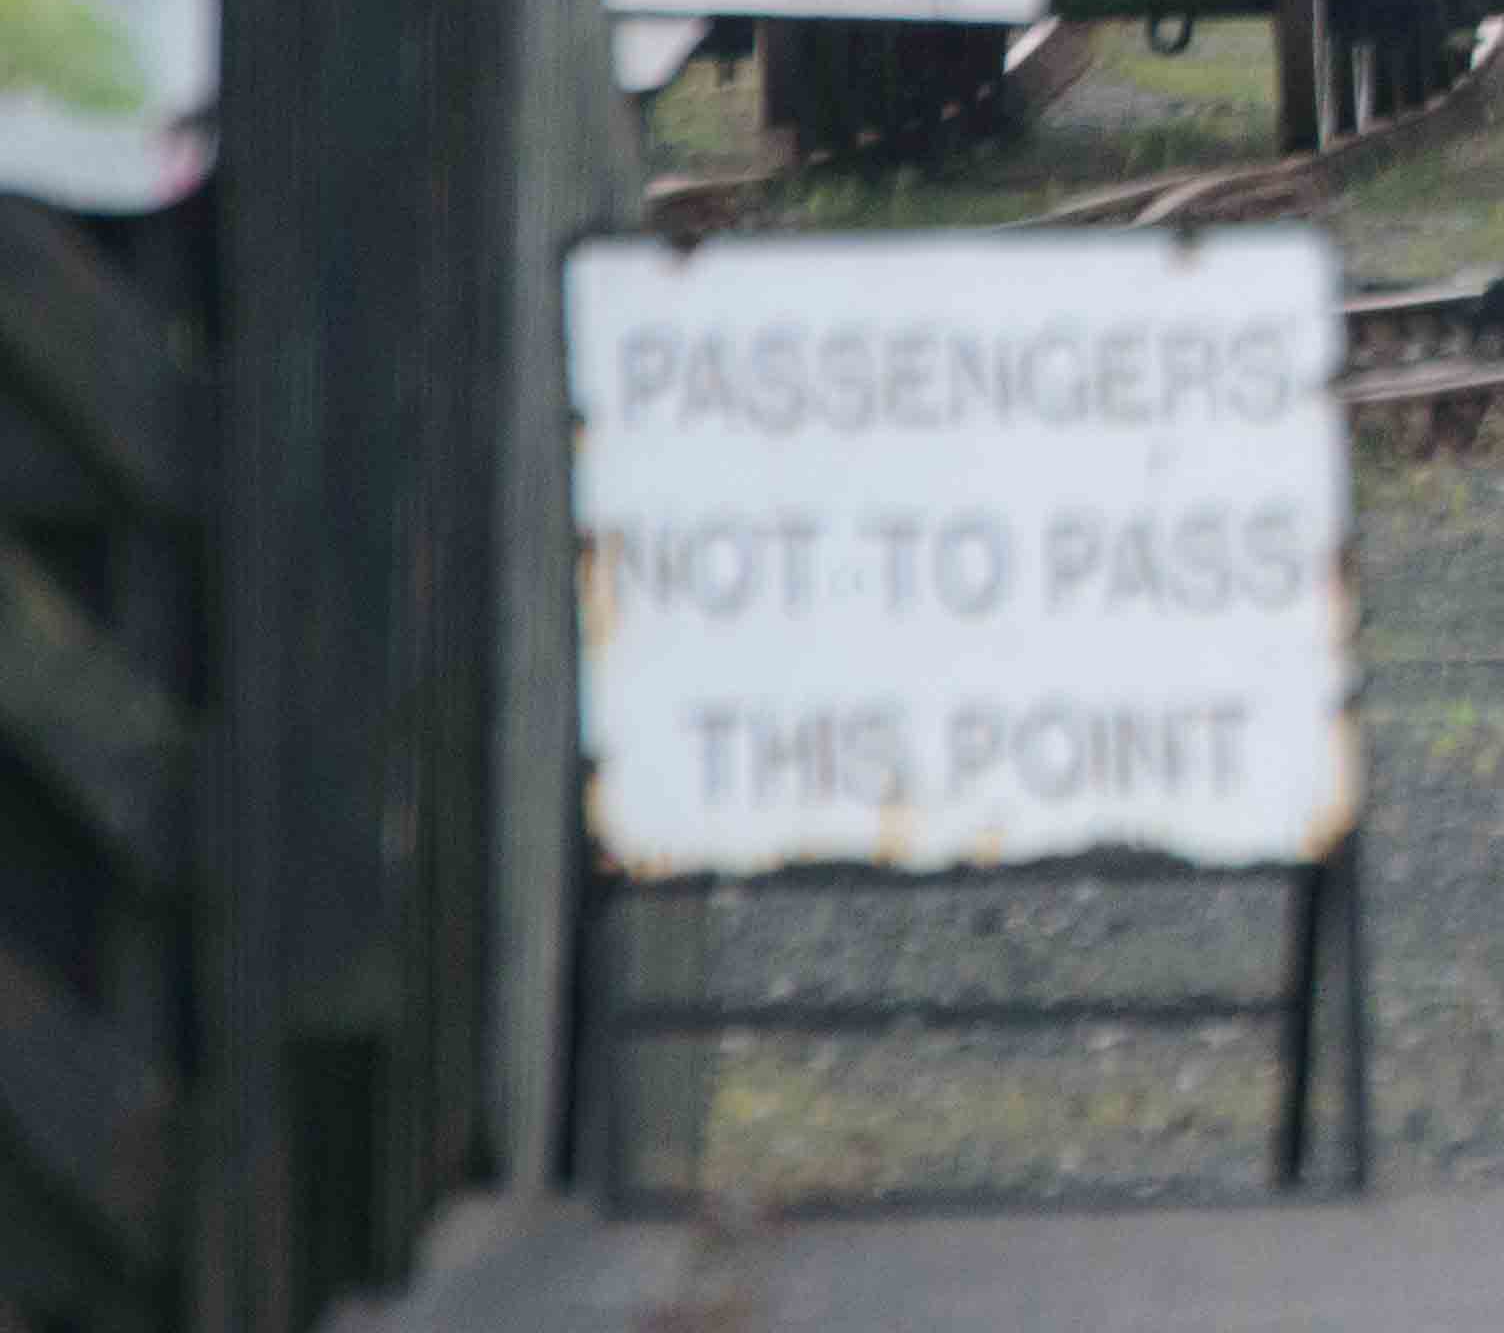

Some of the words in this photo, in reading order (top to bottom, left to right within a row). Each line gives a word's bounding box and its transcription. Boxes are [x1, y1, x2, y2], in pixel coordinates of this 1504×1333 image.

[616, 319, 1300, 435] PASSENGERS
[603, 513, 824, 618] NOT
[856, 511, 1014, 619] TO
[1043, 498, 1308, 617] PASS
[687, 700, 912, 809] THIS
[949, 697, 1254, 803] POINT
